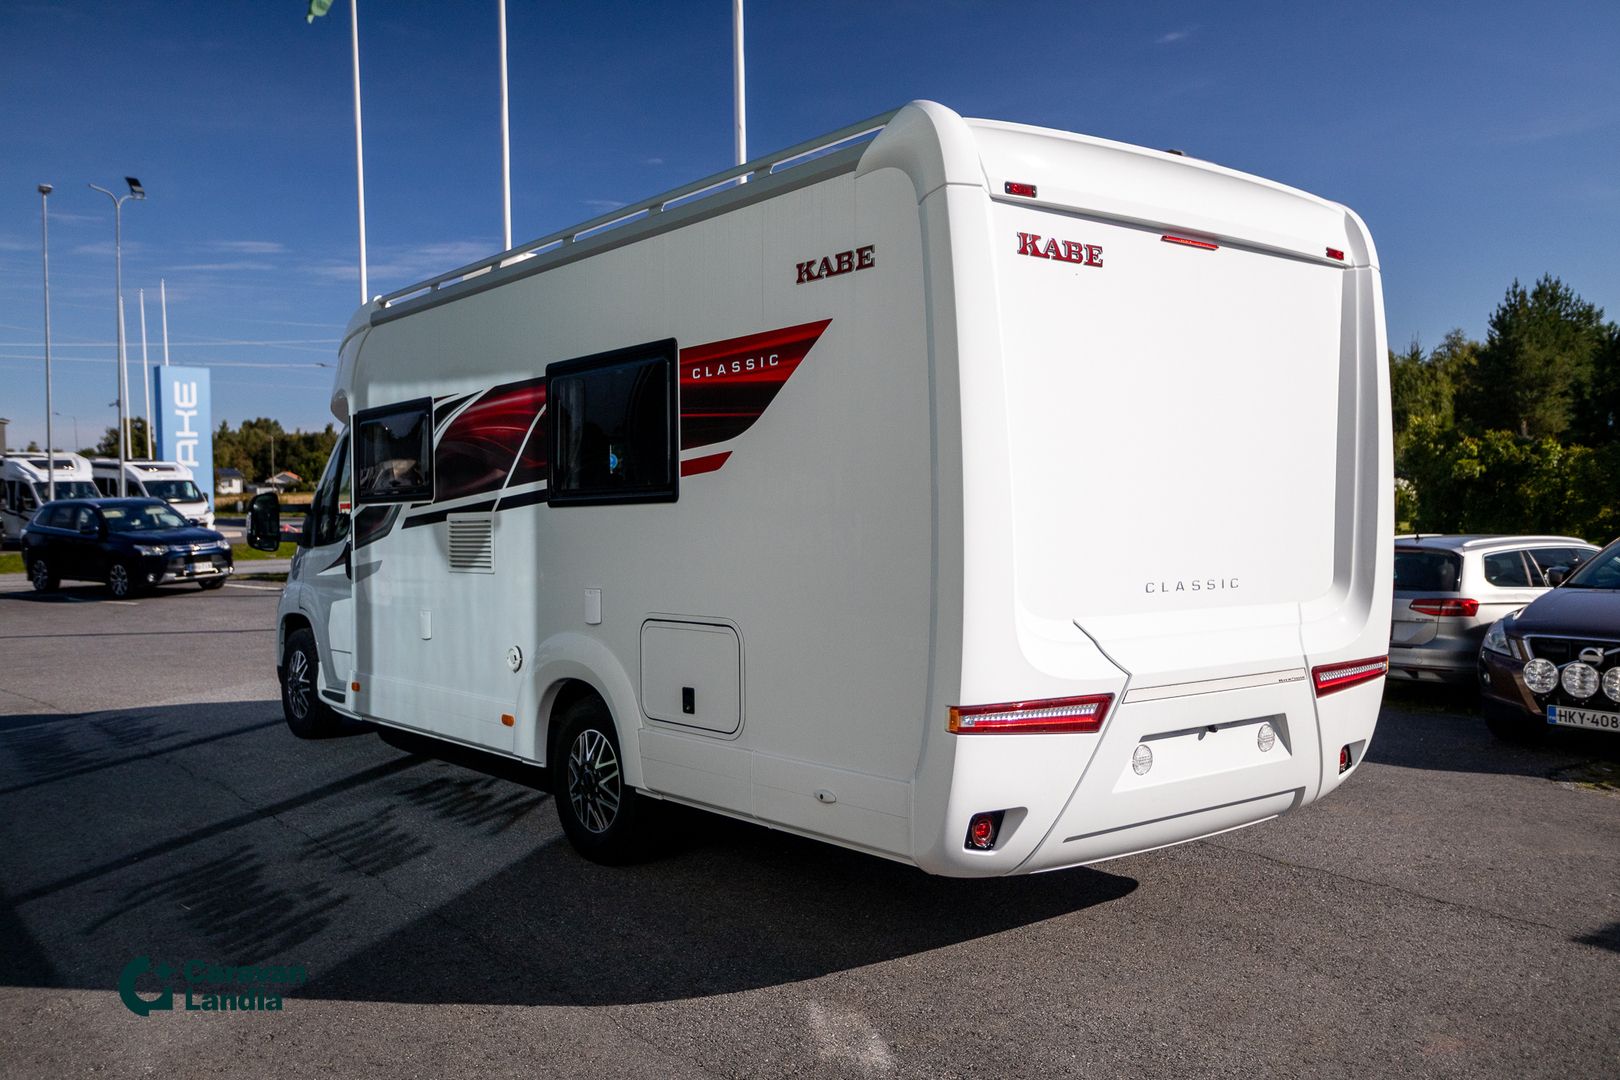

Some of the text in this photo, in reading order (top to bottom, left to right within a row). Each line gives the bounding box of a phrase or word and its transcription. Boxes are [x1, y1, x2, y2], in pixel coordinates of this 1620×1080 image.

[1017, 231, 1104, 268] KABE
[796, 244, 876, 285] KABE
[692, 354, 779, 379] CLASSIC
[1145, 578, 1239, 593] CLASSIC
[1558, 709, 1619, 729] HKY-408
